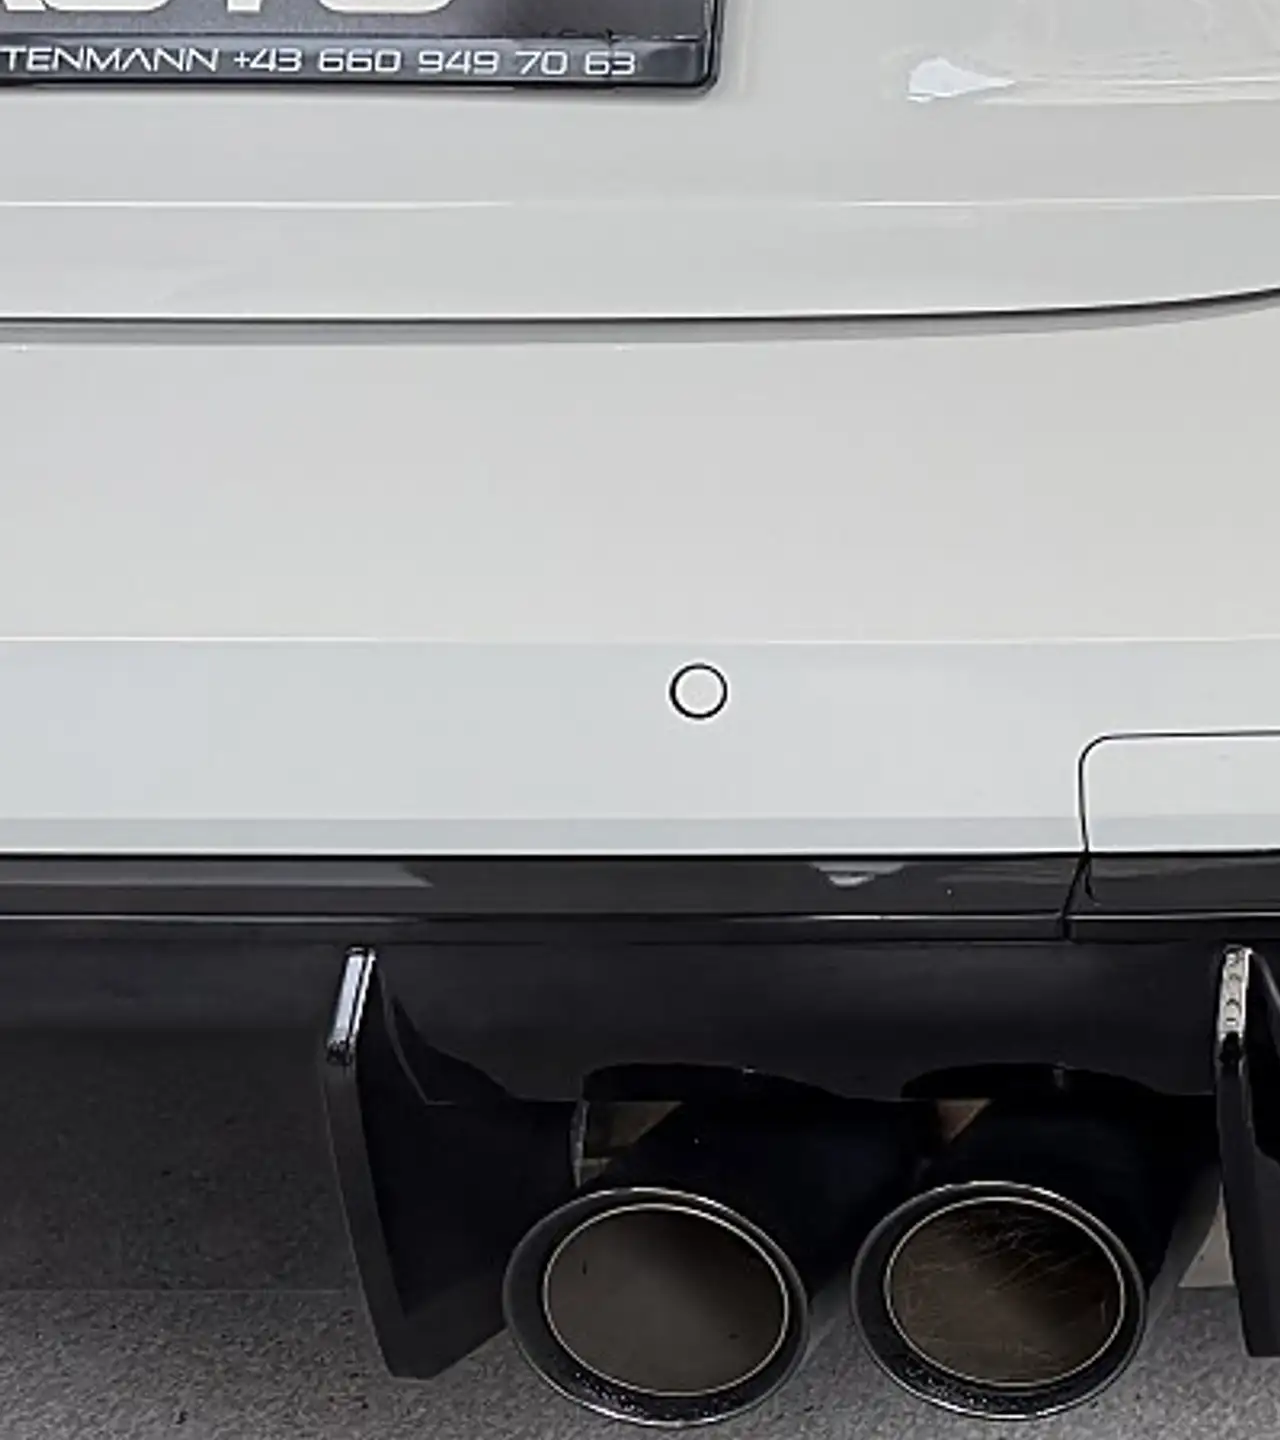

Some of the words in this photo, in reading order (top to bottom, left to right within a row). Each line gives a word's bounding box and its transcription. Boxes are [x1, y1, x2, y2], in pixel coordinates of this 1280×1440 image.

[233, 47, 302, 73] +43
[317, 48, 401, 75] 660
[417, 49, 499, 75] 949
[514, 50, 568, 75] 70
[584, 51, 636, 77] 63
